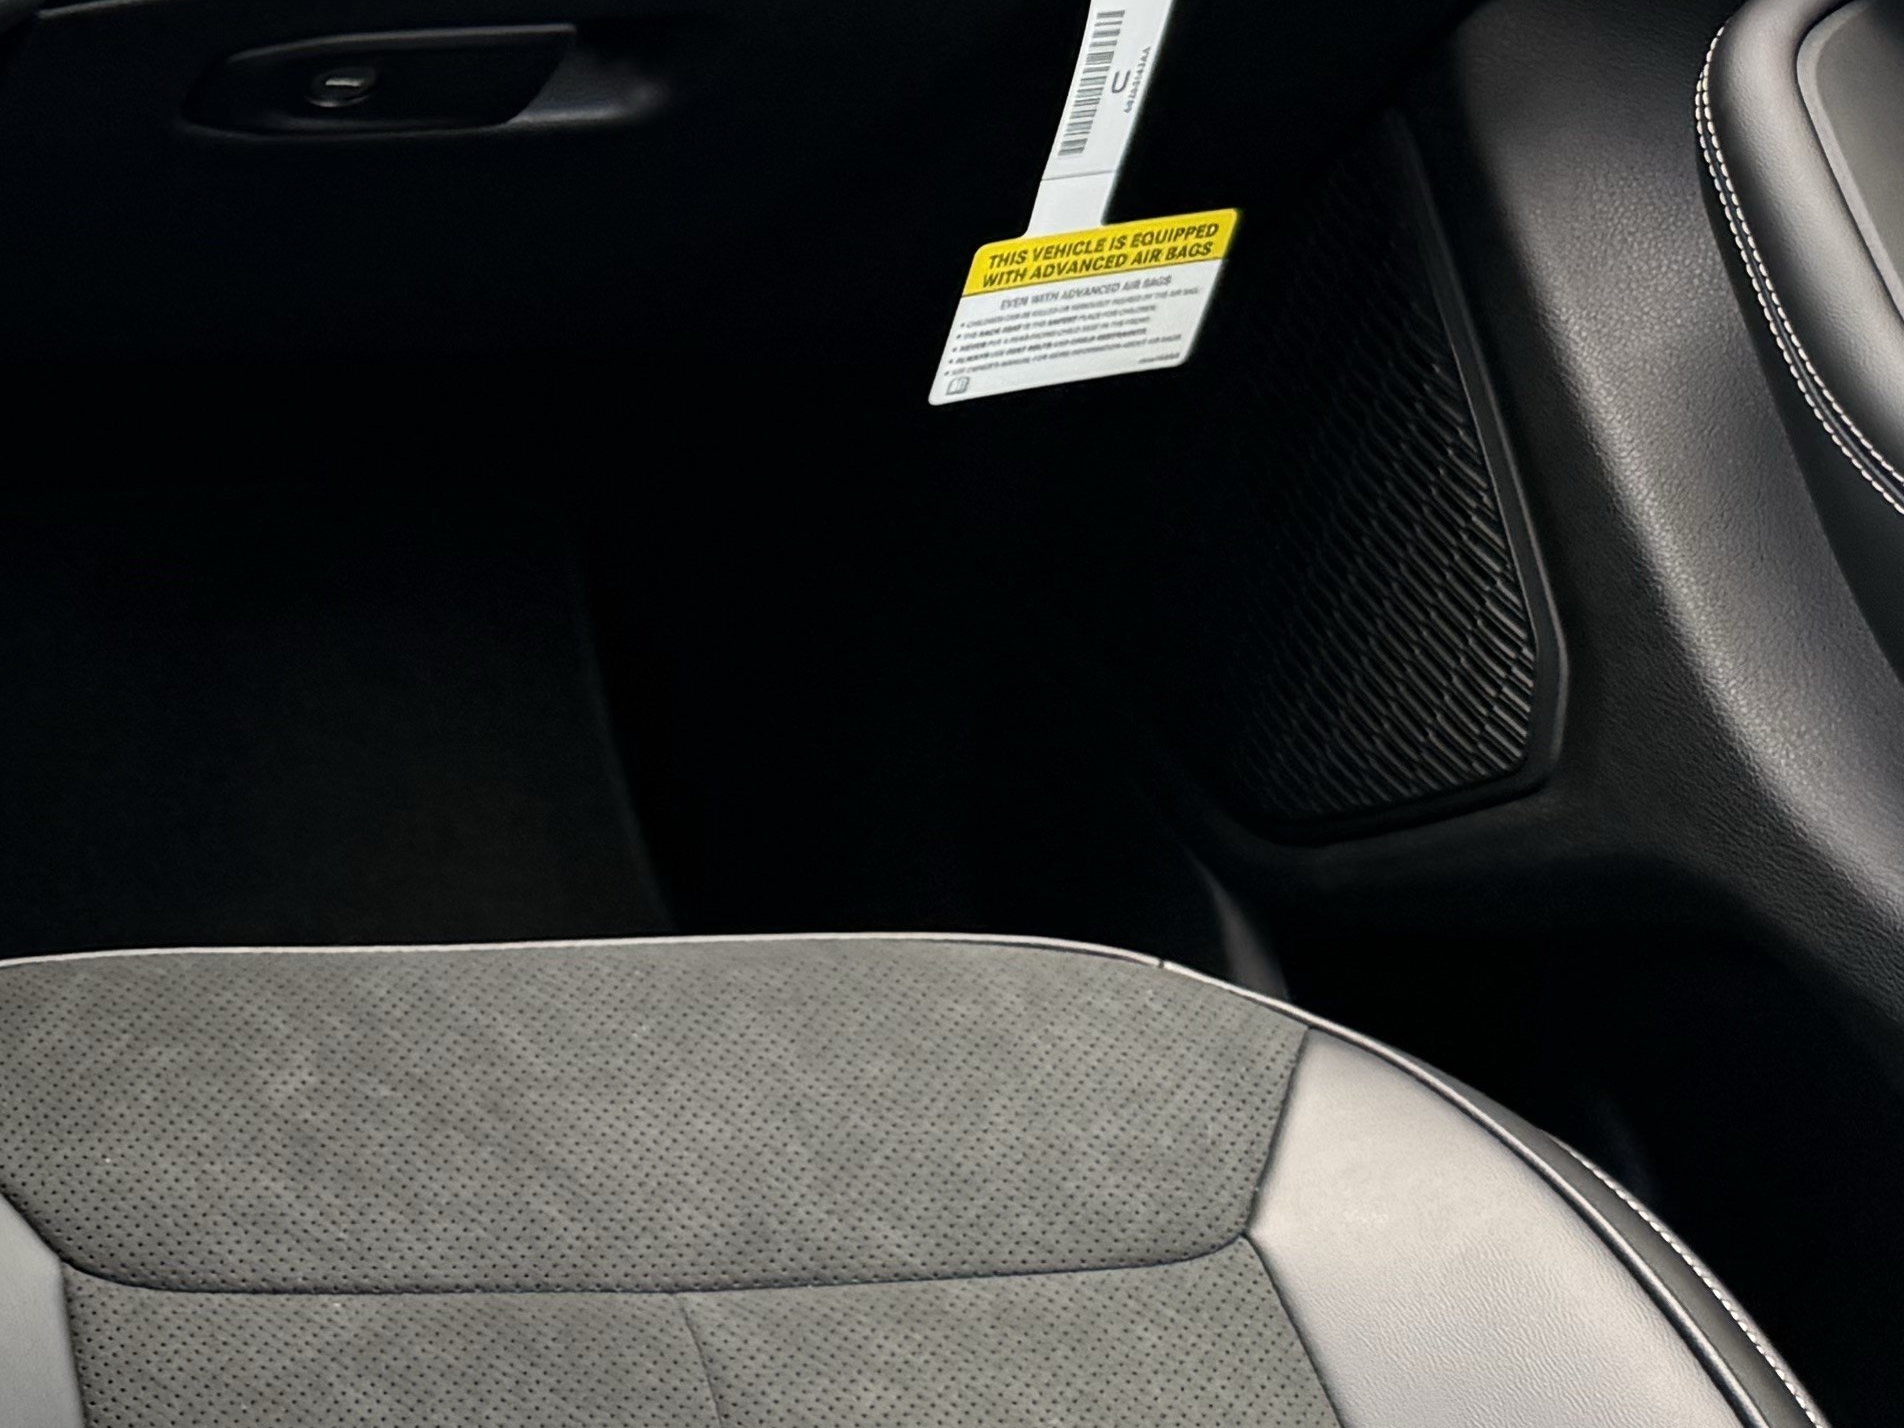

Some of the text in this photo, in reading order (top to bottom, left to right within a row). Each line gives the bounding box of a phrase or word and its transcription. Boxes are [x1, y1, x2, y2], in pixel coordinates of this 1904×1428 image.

[982, 241, 1213, 288] WITH ADVANCED AIR BAGS
[989, 222, 1219, 269] THIS VEHICLE IS EQUIPPED
